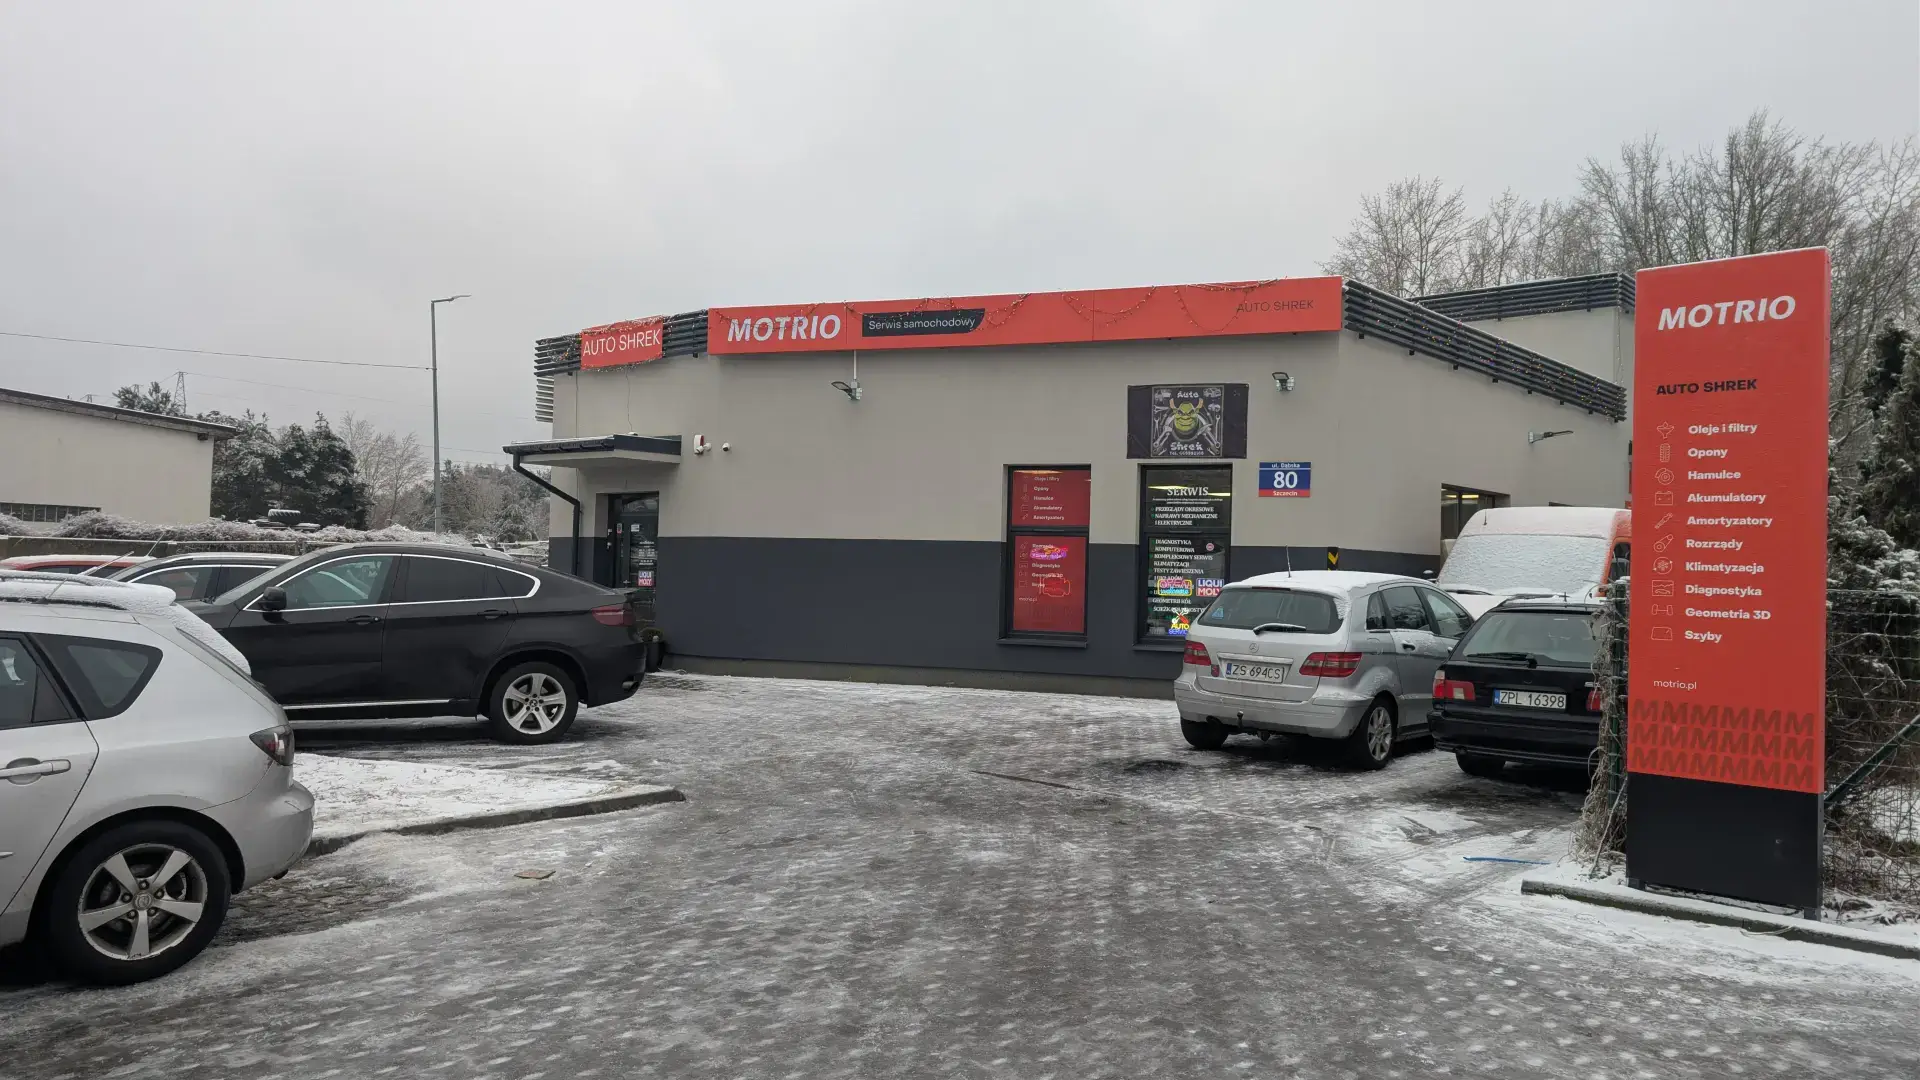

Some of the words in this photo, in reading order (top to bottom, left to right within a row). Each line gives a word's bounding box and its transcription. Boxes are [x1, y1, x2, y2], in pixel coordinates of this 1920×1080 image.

[1237, 302, 1270, 313] AUTO
[1274, 300, 1314, 311] SHREK
[1658, 295, 1796, 330] MOTRIO
[728, 314, 842, 342] MOTRIO
[868, 320, 902, 330] Serwis
[903, 316, 976, 330] samochodowy
[582, 336, 616, 357] AUTO
[618, 328, 661, 351] SHREK
[1656, 382, 1700, 395] AUTO
[1704, 378, 1758, 392] SHREK
[1688, 424, 1720, 436] Oleje
[1722, 424, 1726, 433] i
[1728, 423, 1758, 434] filtry
[1170, 442, 1204, 452] Shrek
[1688, 448, 1728, 459] Opony
[1274, 471, 1298, 488] 80
[1688, 470, 1741, 480] Hamulce
[1167, 486, 1209, 496] SERWIS
[1688, 493, 1766, 504] Akumulatory
[1687, 516, 1772, 528] Amortyzatory
[1686, 539, 1743, 550] Rozrządy
[1686, 562, 1764, 574] Klimatyzacja
[1685, 584, 1762, 598] Diagnostyka
[1685, 608, 1750, 619] Geometria
[1753, 610, 1771, 620] 3D
[1685, 630, 1722, 643] Szyby
[1232, 664, 1247, 676] ZS
[1249, 666, 1280, 679] 694CS
[1653, 680, 1697, 691] motrio.pl
[1500, 692, 1522, 704] ZPL
[1528, 694, 1564, 708] 16398
